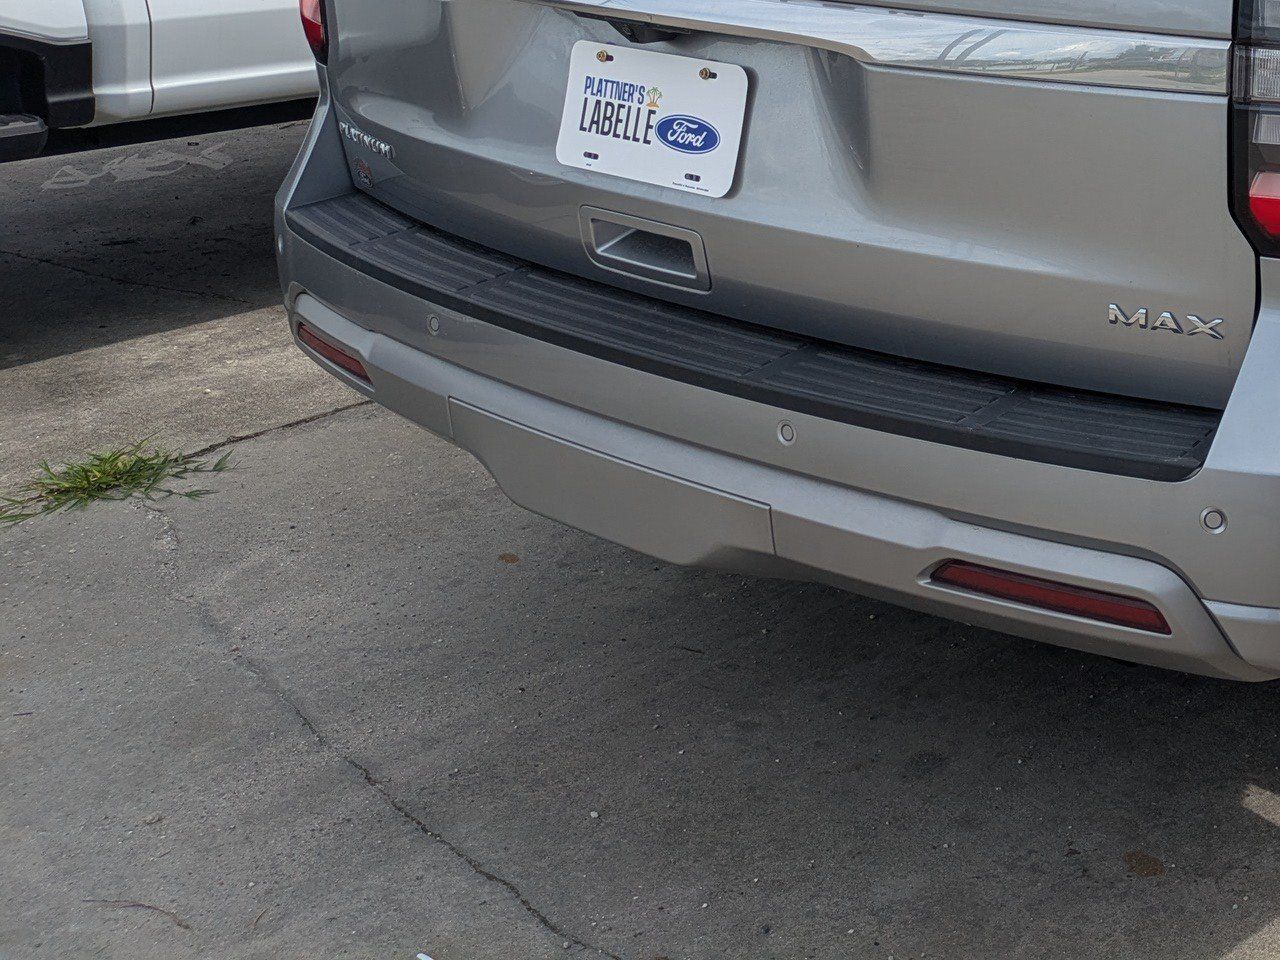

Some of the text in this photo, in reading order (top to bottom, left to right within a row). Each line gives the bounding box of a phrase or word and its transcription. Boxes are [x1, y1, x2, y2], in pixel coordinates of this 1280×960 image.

[584, 75, 646, 105] PLATTNER'S
[579, 97, 657, 145] LABELLE
[667, 120, 707, 147] Ford
[1108, 303, 1224, 340] MAX
